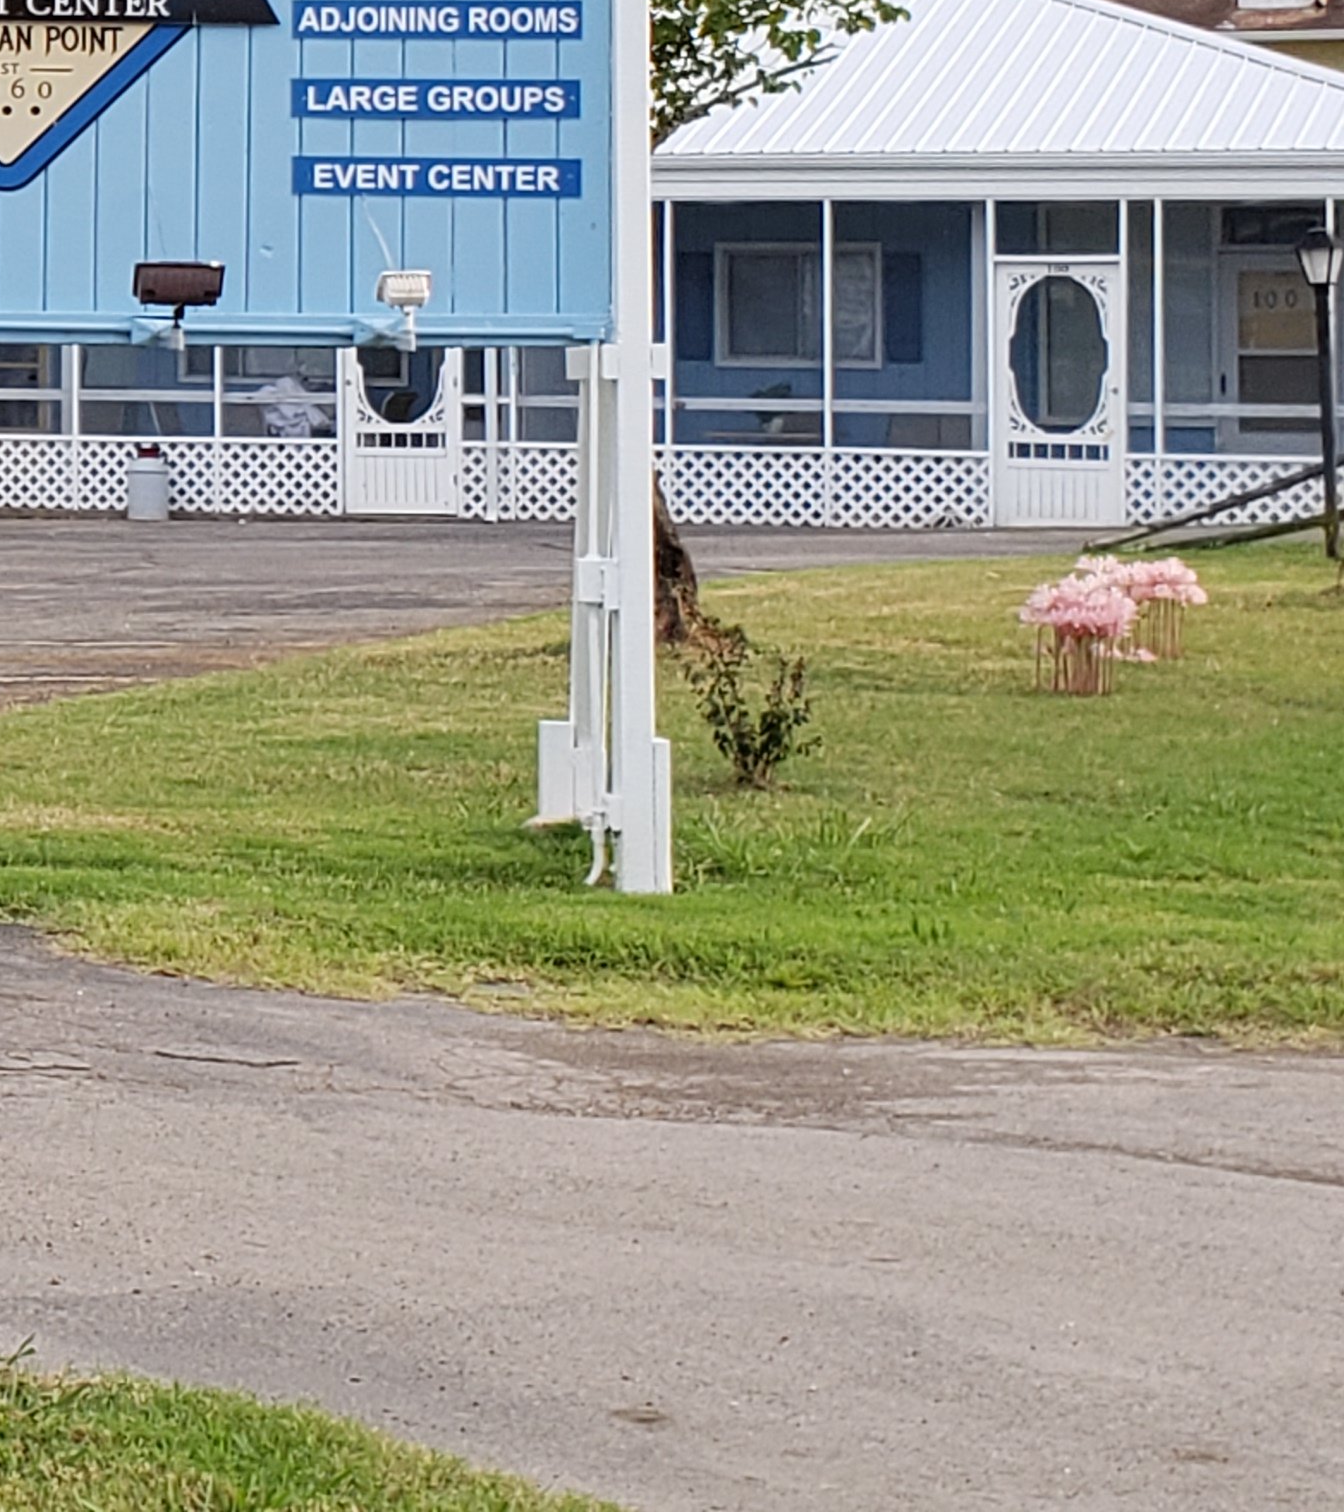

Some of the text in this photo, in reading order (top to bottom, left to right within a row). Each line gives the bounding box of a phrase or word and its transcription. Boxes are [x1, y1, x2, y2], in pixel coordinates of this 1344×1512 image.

[297, 7, 578, 33] ADJOINING ROOMS
[45, 25, 124, 55] POINT
[307, 86, 565, 112] LARGE GROUPS
[313, 164, 560, 191] EVENT CENTER
